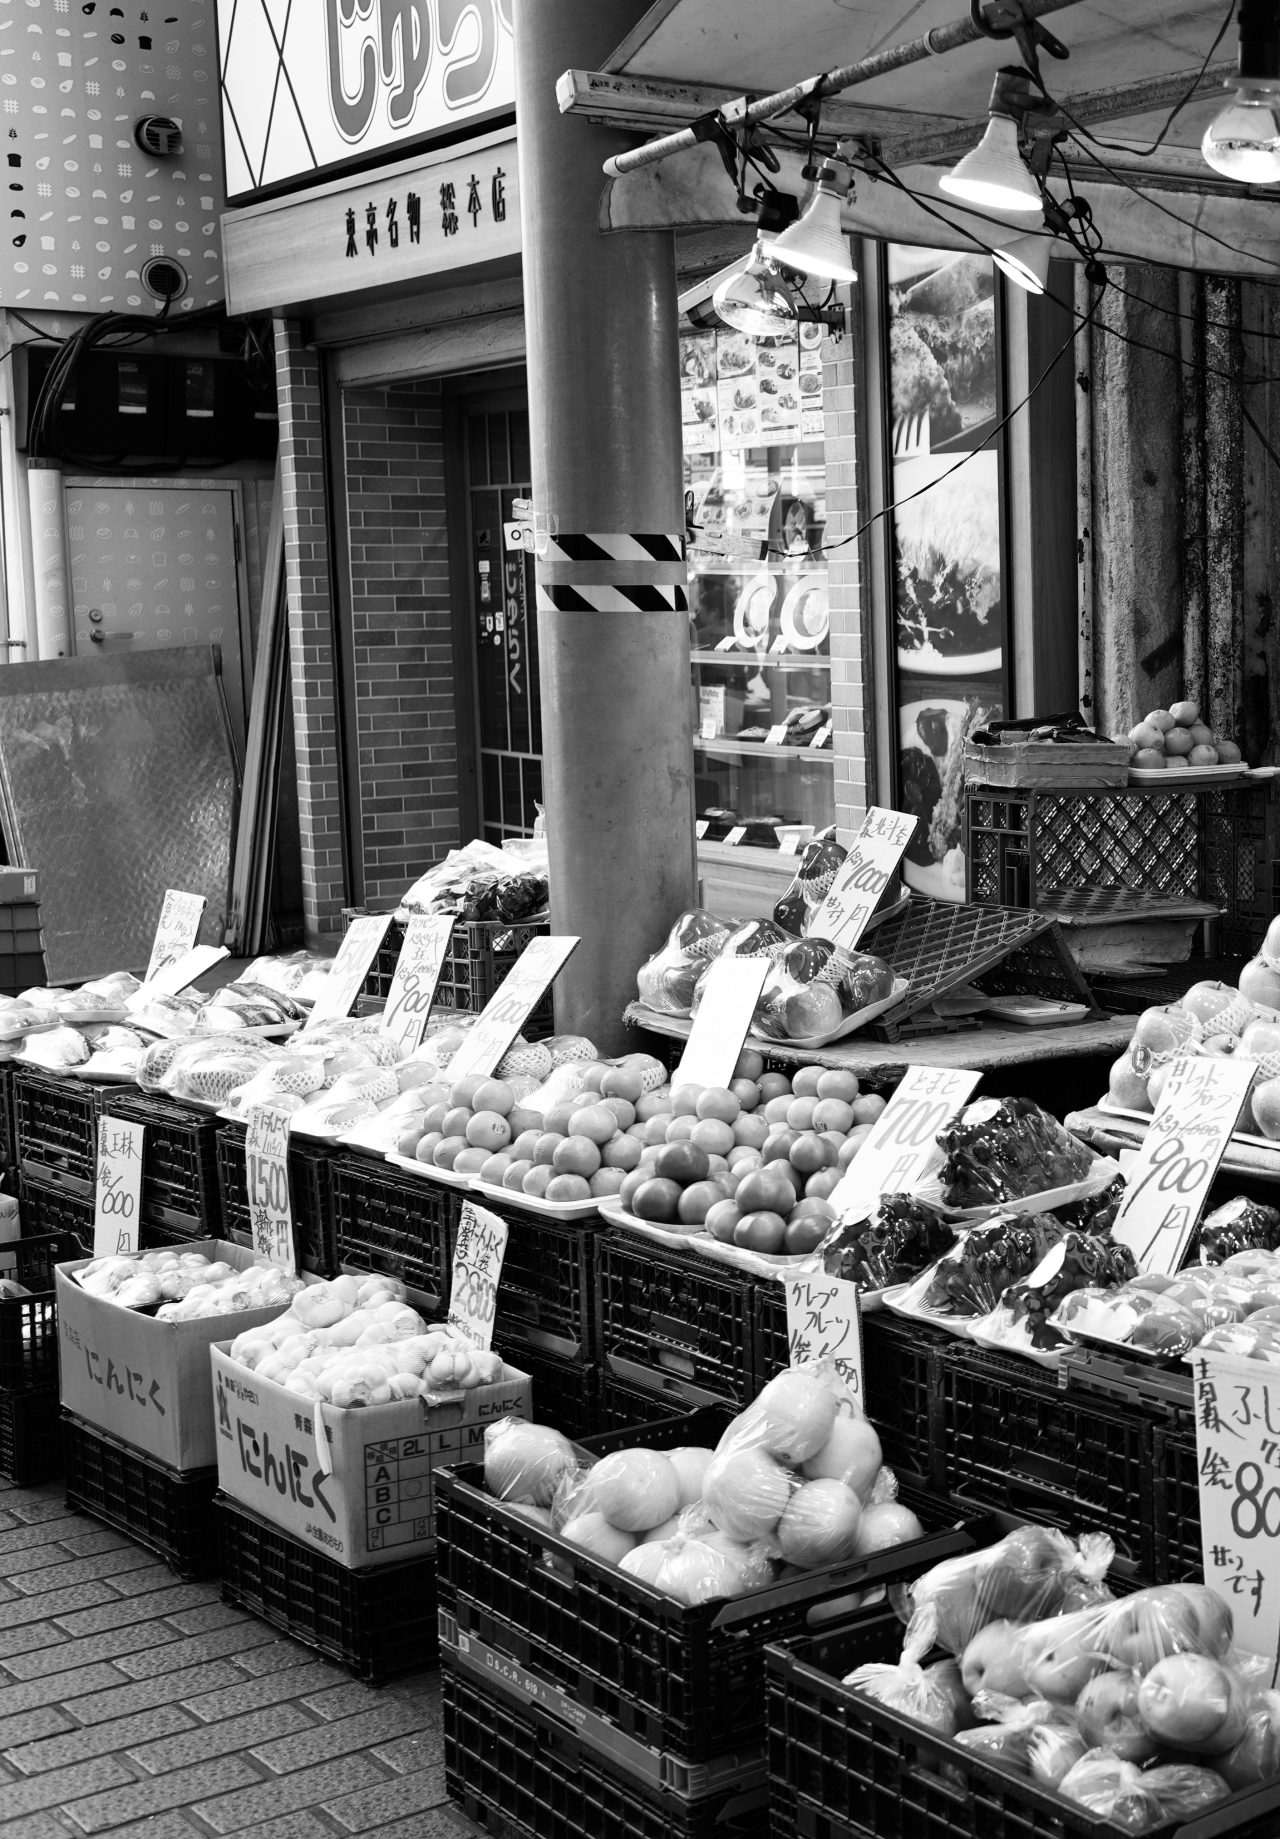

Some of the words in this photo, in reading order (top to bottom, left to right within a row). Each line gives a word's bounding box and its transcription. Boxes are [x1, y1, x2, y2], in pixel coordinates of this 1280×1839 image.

[345, 192, 421, 258] 東京名物
[386, 974, 431, 1028] 900
[909, 1069, 961, 1096] とまと
[873, 1096, 951, 1152] 700
[112, 1131, 143, 1161] 王林
[250, 1154, 290, 1215] 1500
[879, 1152, 920, 1195] 円
[1121, 1137, 1209, 1219] 900
[102, 1175, 135, 1218] 600
[1139, 1203, 1191, 1276] 円
[453, 1261, 498, 1314] 2800
[84, 1344, 166, 1417] にんにく
[293, 1412, 333, 1444] 青森産
[478, 1396, 523, 1417] にんにく
[403, 1440, 425, 1457] 2L
[439, 1434, 452, 1450] L
[468, 1428, 485, 1444] M
[236, 1416, 337, 1524] にんにく
[374, 1466, 392, 1484] A
[375, 1486, 391, 1504] B
[376, 1507, 392, 1525] C
